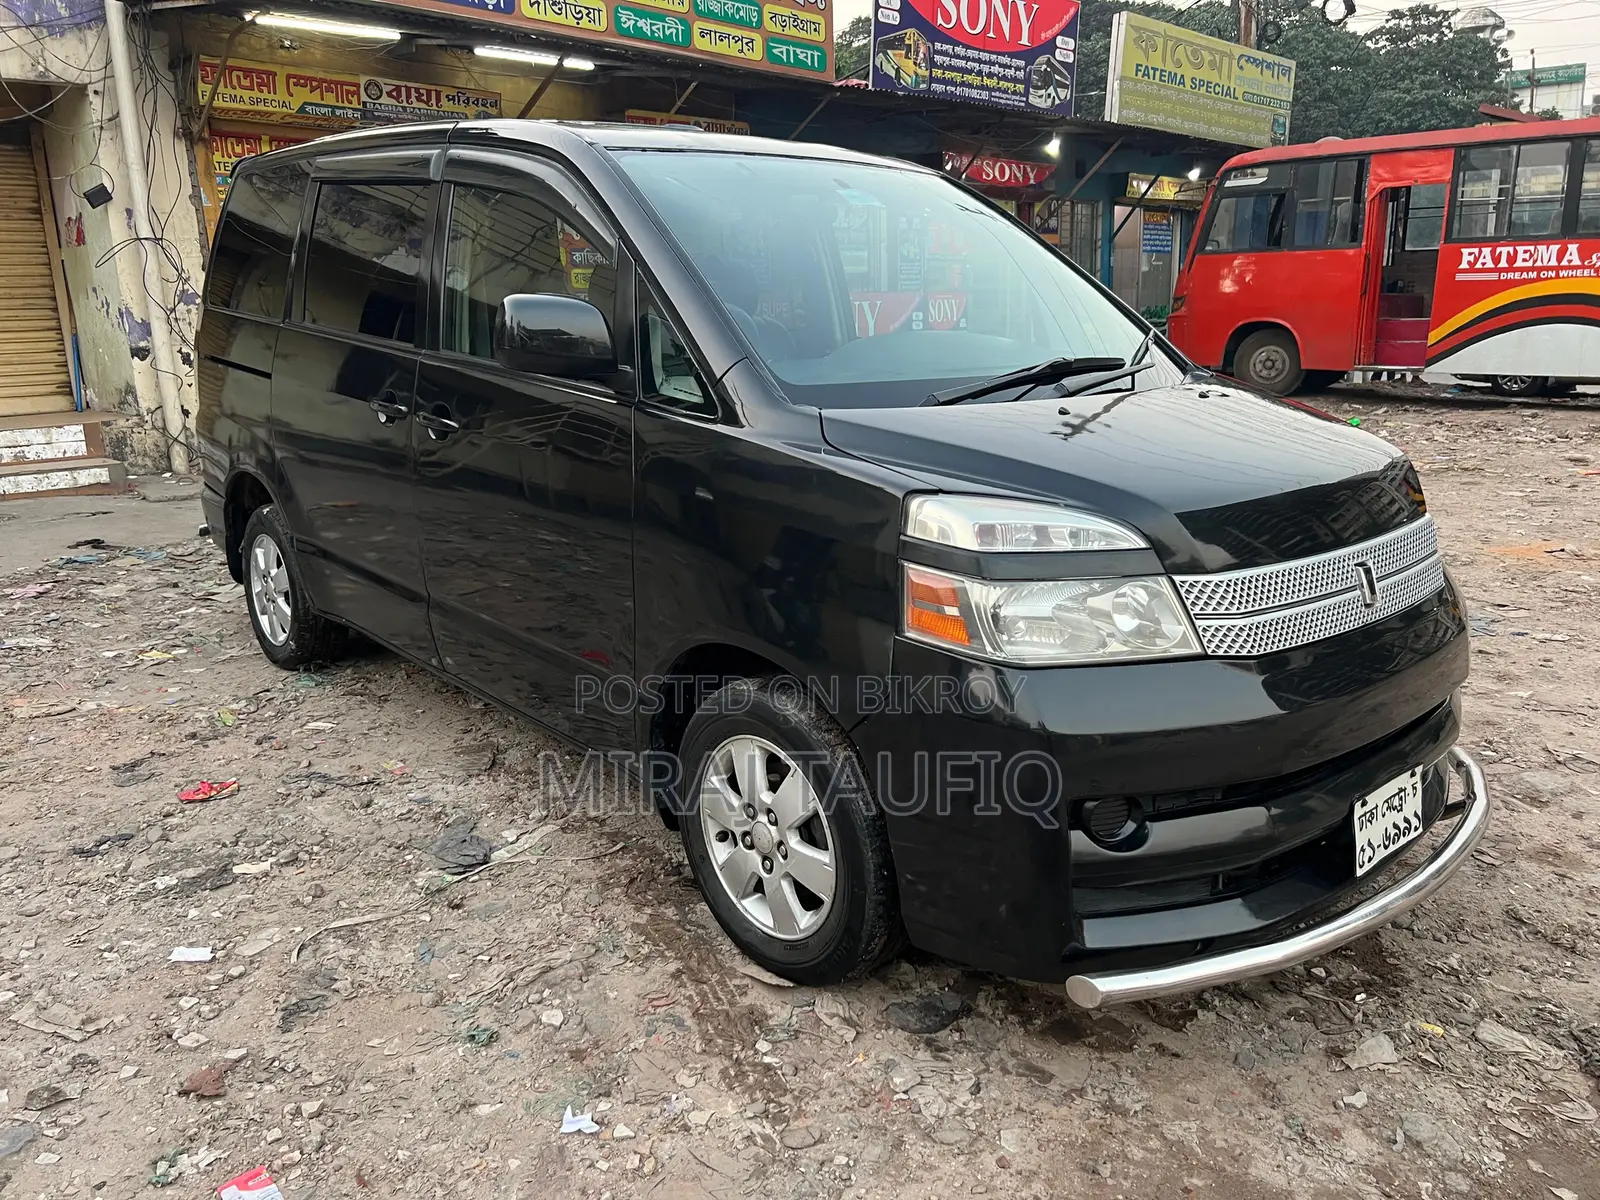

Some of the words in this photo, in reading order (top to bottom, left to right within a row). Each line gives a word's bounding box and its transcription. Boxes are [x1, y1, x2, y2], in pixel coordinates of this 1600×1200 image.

[617, 8, 684, 43] ঈশ্বরদী
[768, 11, 821, 36] বড়াইগ্রাম
[937, 0, 1040, 46] SONY
[698, 27, 756, 56] লালপুর
[769, 42, 821, 68] বাঘা
[1135, 63, 1186, 88] FATEMA
[1189, 77, 1239, 101] SPECIAL
[201, 90, 246, 105] FTEMA
[248, 96, 295, 111] SPECIAL
[383, 83, 444, 108] বাঘা
[445, 91, 499, 110] পরিবহন
[304, 105, 332, 118] বাংলা
[335, 109, 361, 120] লাইন
[366, 102, 403, 112] BAGHA
[407, 107, 466, 119] PARIBAHAN
[982, 160, 1038, 185] SONY
[1458, 243, 1582, 269] FATEMA
[1500, 271, 1537, 280] DREAM
[1540, 270, 1556, 278] ON
[1558, 268, 1600, 278] WHEEL
[762, 303, 791, 318] SUPE
[928, 298, 960, 323] SONY
[1358, 803, 1378, 832] ঢাকা
